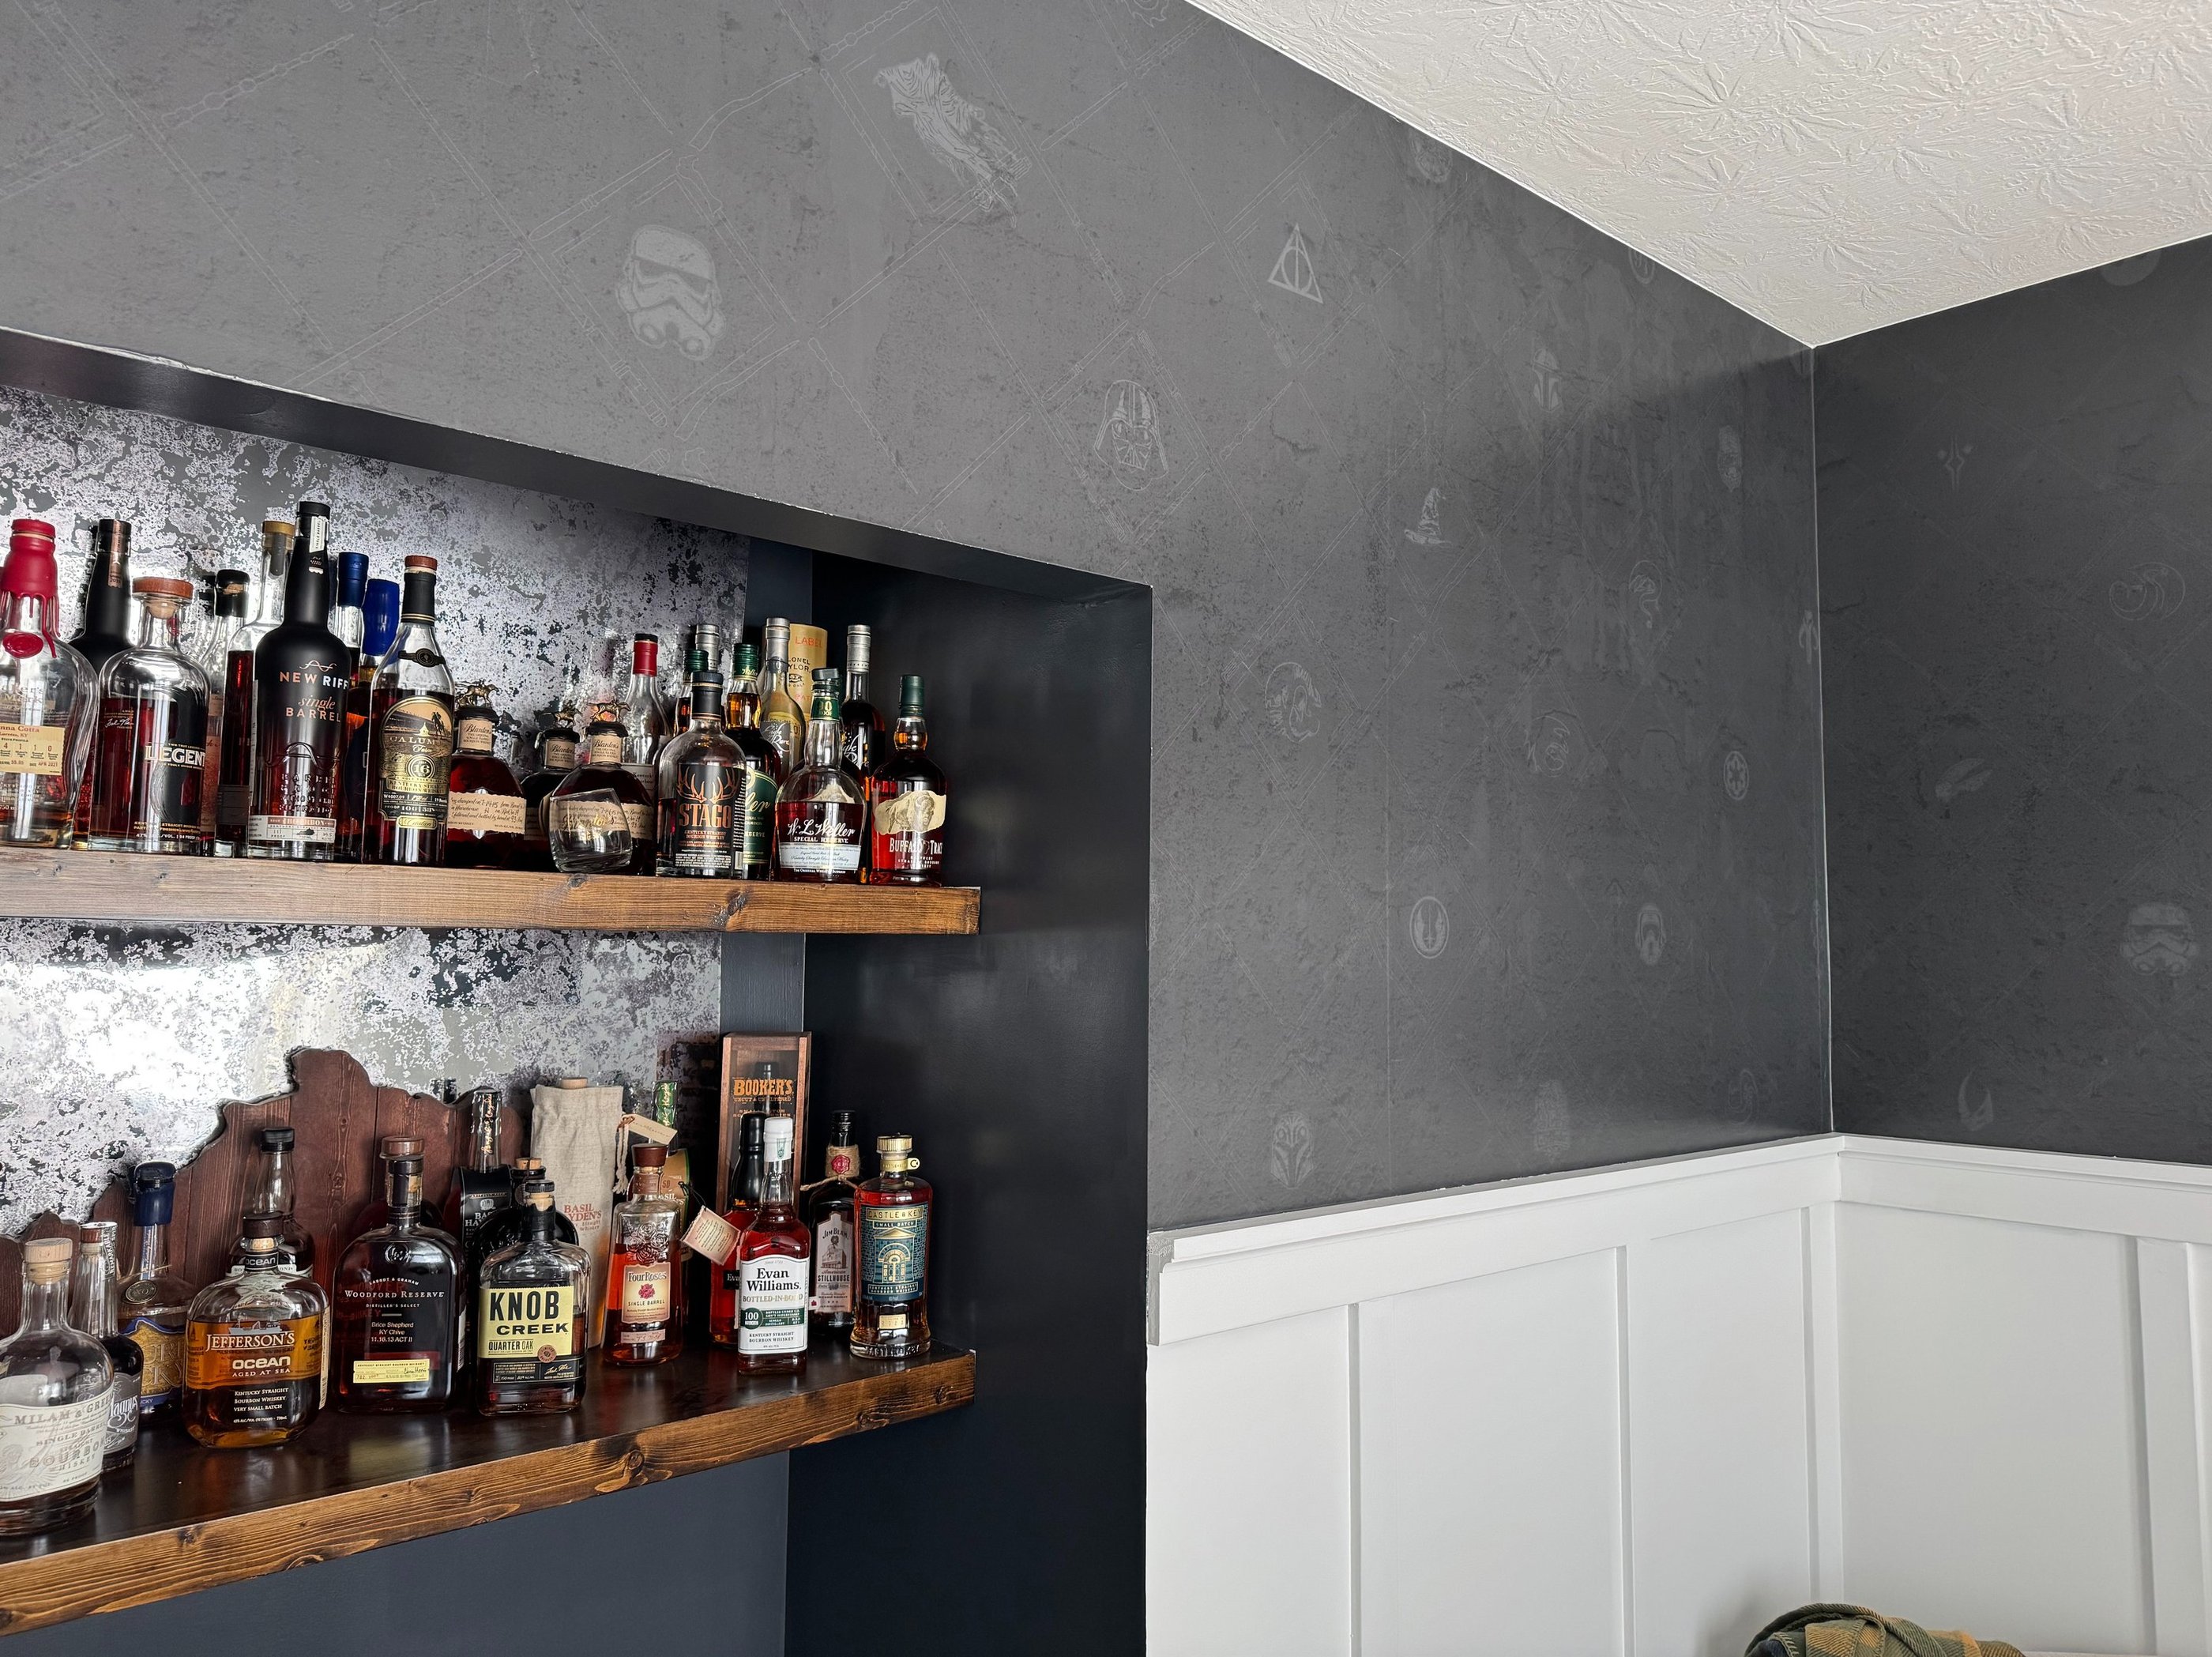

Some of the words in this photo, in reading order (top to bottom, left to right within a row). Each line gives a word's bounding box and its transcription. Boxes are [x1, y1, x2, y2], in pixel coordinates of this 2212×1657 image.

[795, 636, 822, 647] LABEL
[280, 672, 317, 684] NEW
[323, 675, 349, 689] RIFF
[299, 695, 335, 712] single
[286, 707, 340, 722] BARREL
[390, 736, 435, 745] CALUM
[814, 819, 856, 837] Weller
[890, 838, 923, 853] BUFFALO
[734, 1079, 793, 1096] BOOKER'S
[564, 1203, 594, 1213] BASIL
[908, 1208, 923, 1217] KEY
[568, 1211, 602, 1221] YDEN'S
[103, 1233, 115, 1275] REMARKABLE
[756, 1268, 789, 1279] Evan
[344, 1290, 397, 1298] WOODFORD
[490, 1291, 559, 1320] KNOB
[497, 1323, 568, 1335] CREEK
[205, 1331, 295, 1352] JEFFERSON'S
[489, 1341, 520, 1350] QUARTER
[521, 1340, 533, 1350] OAK
[15, 1410, 71, 1425] MILAM
[36, 1432, 77, 1446] SINGLE
